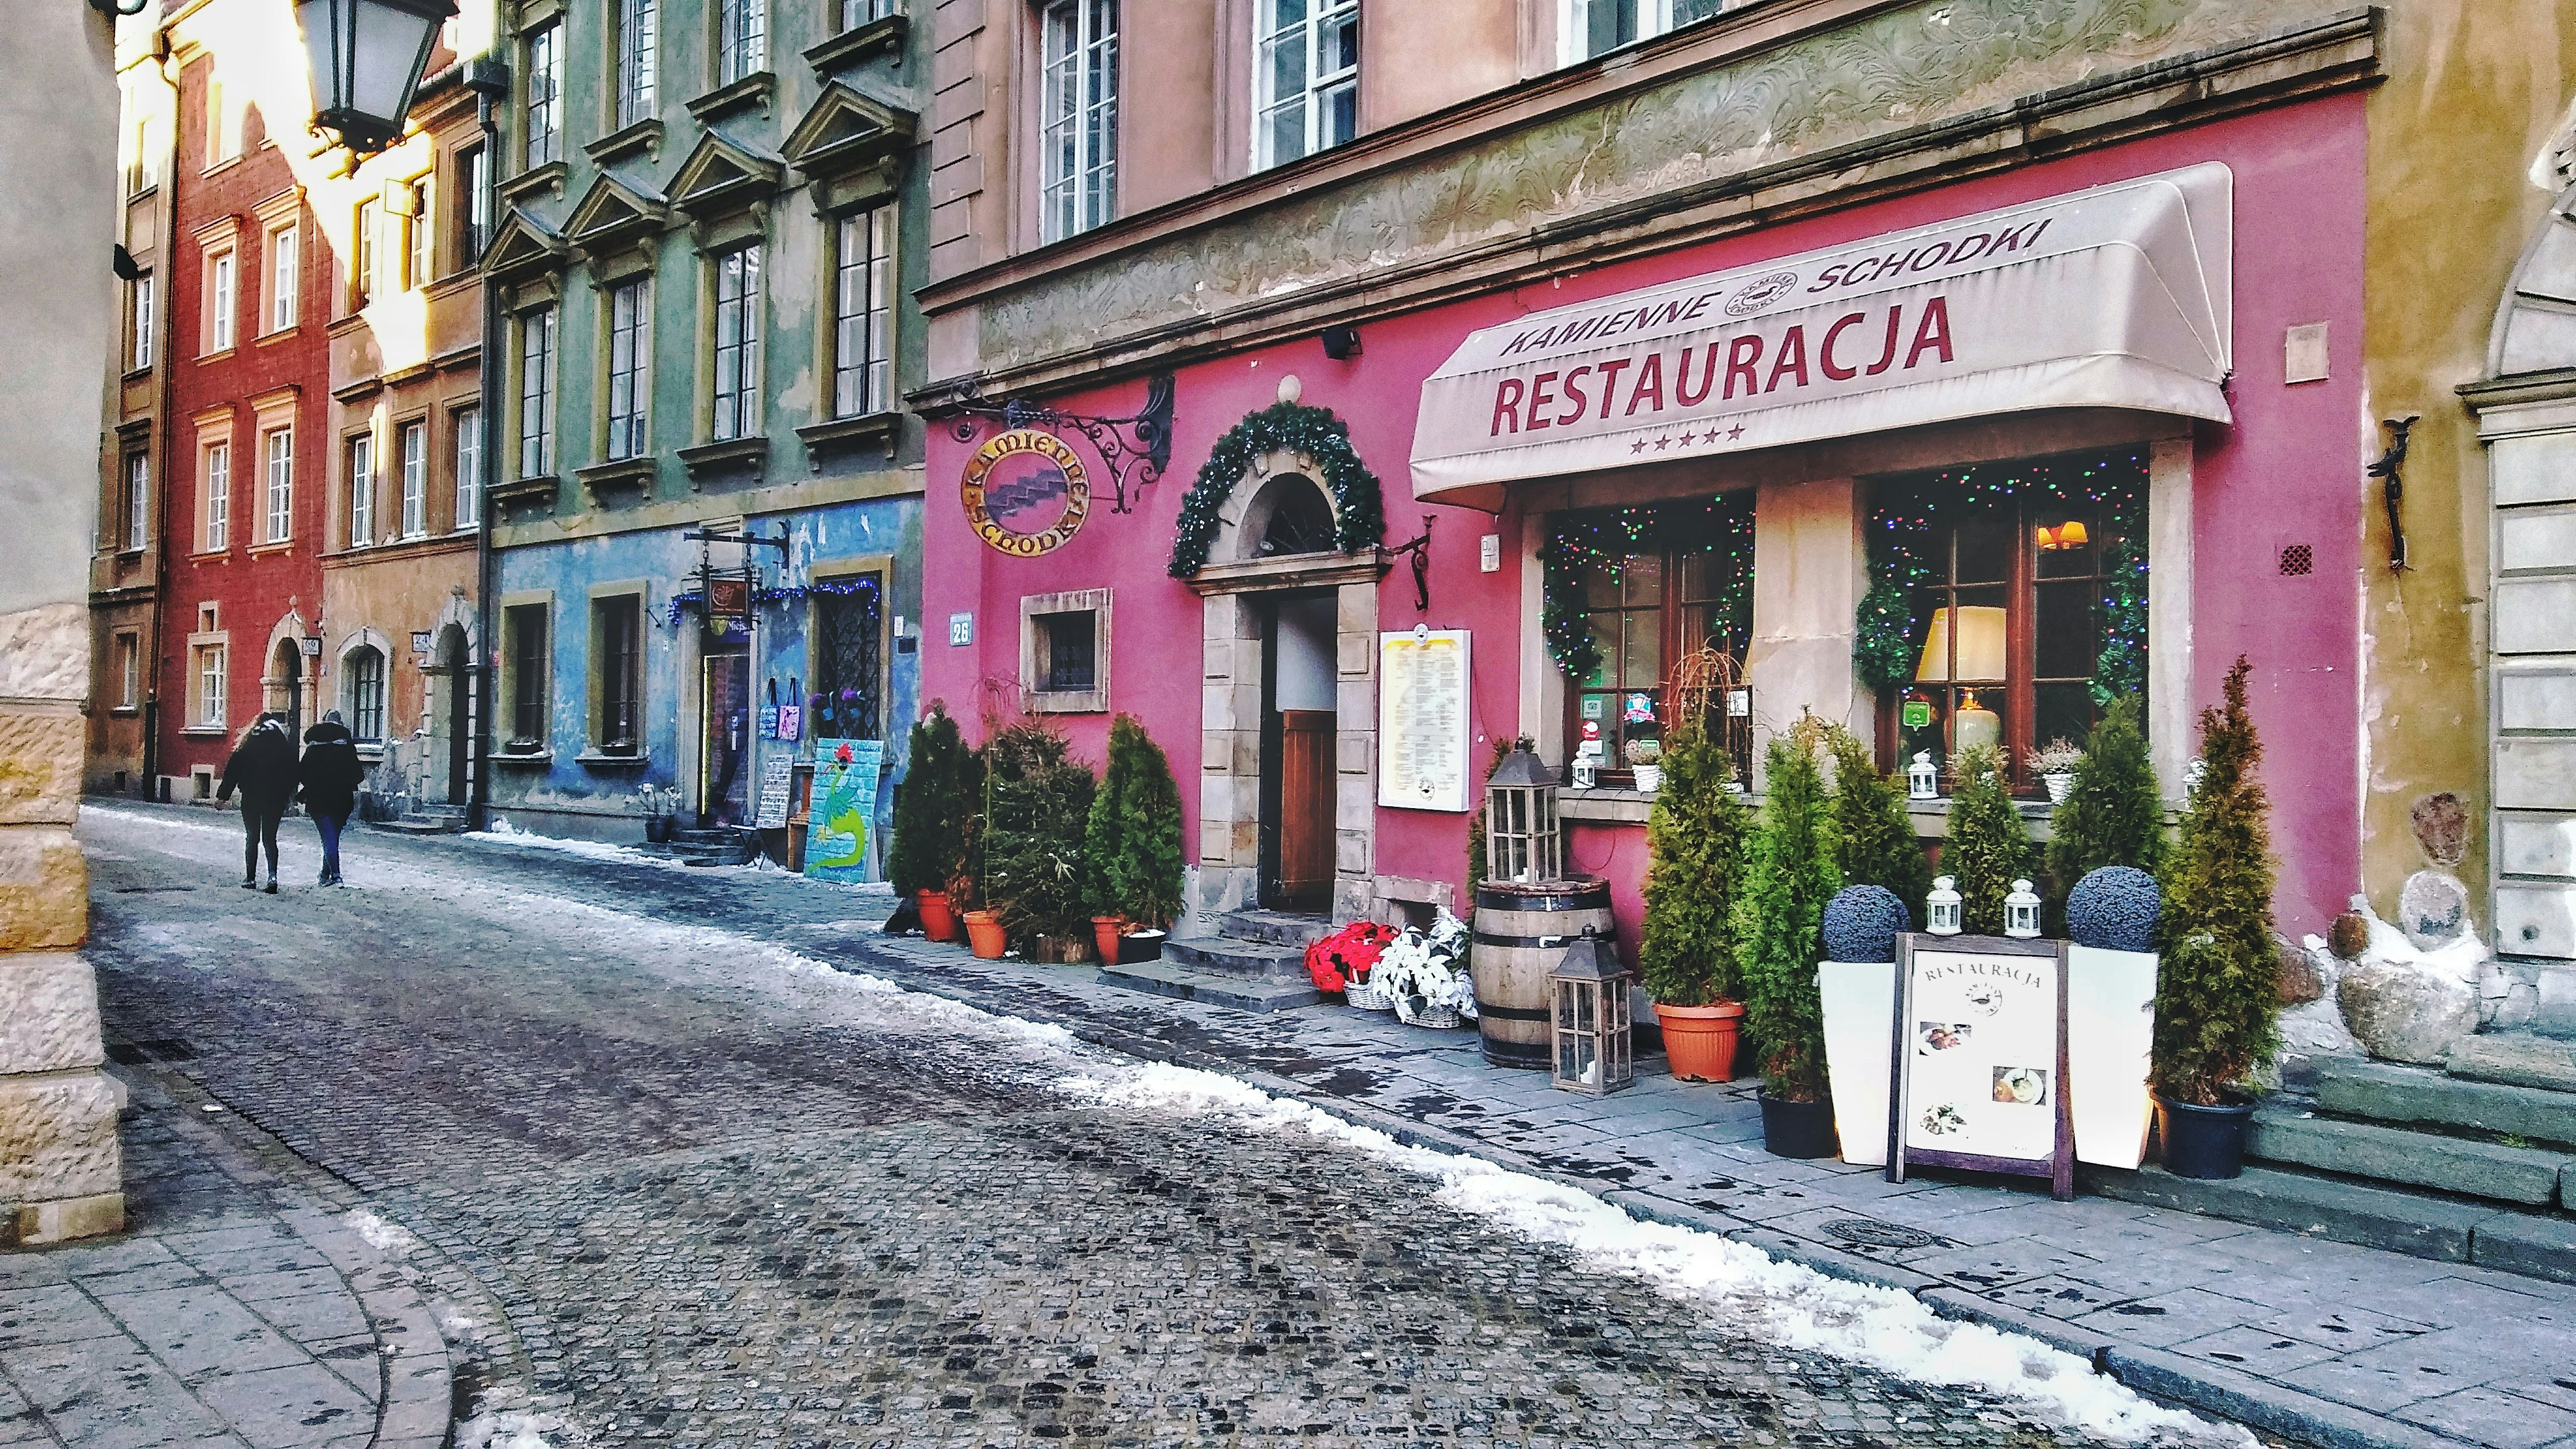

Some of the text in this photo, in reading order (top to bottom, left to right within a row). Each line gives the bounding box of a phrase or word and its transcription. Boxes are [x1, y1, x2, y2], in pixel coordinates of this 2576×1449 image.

[1499, 217, 2053, 357] KAMIENNE SCHODKI
[1491, 295, 1955, 435] RESTAURACJA
[966, 432, 1088, 497] KAMIENNE
[967, 505, 1084, 554] SCHODKI
[416, 635, 428, 644] 24
[954, 622, 968, 643] 26
[1925, 964, 2040, 988] RESTAURACJA
